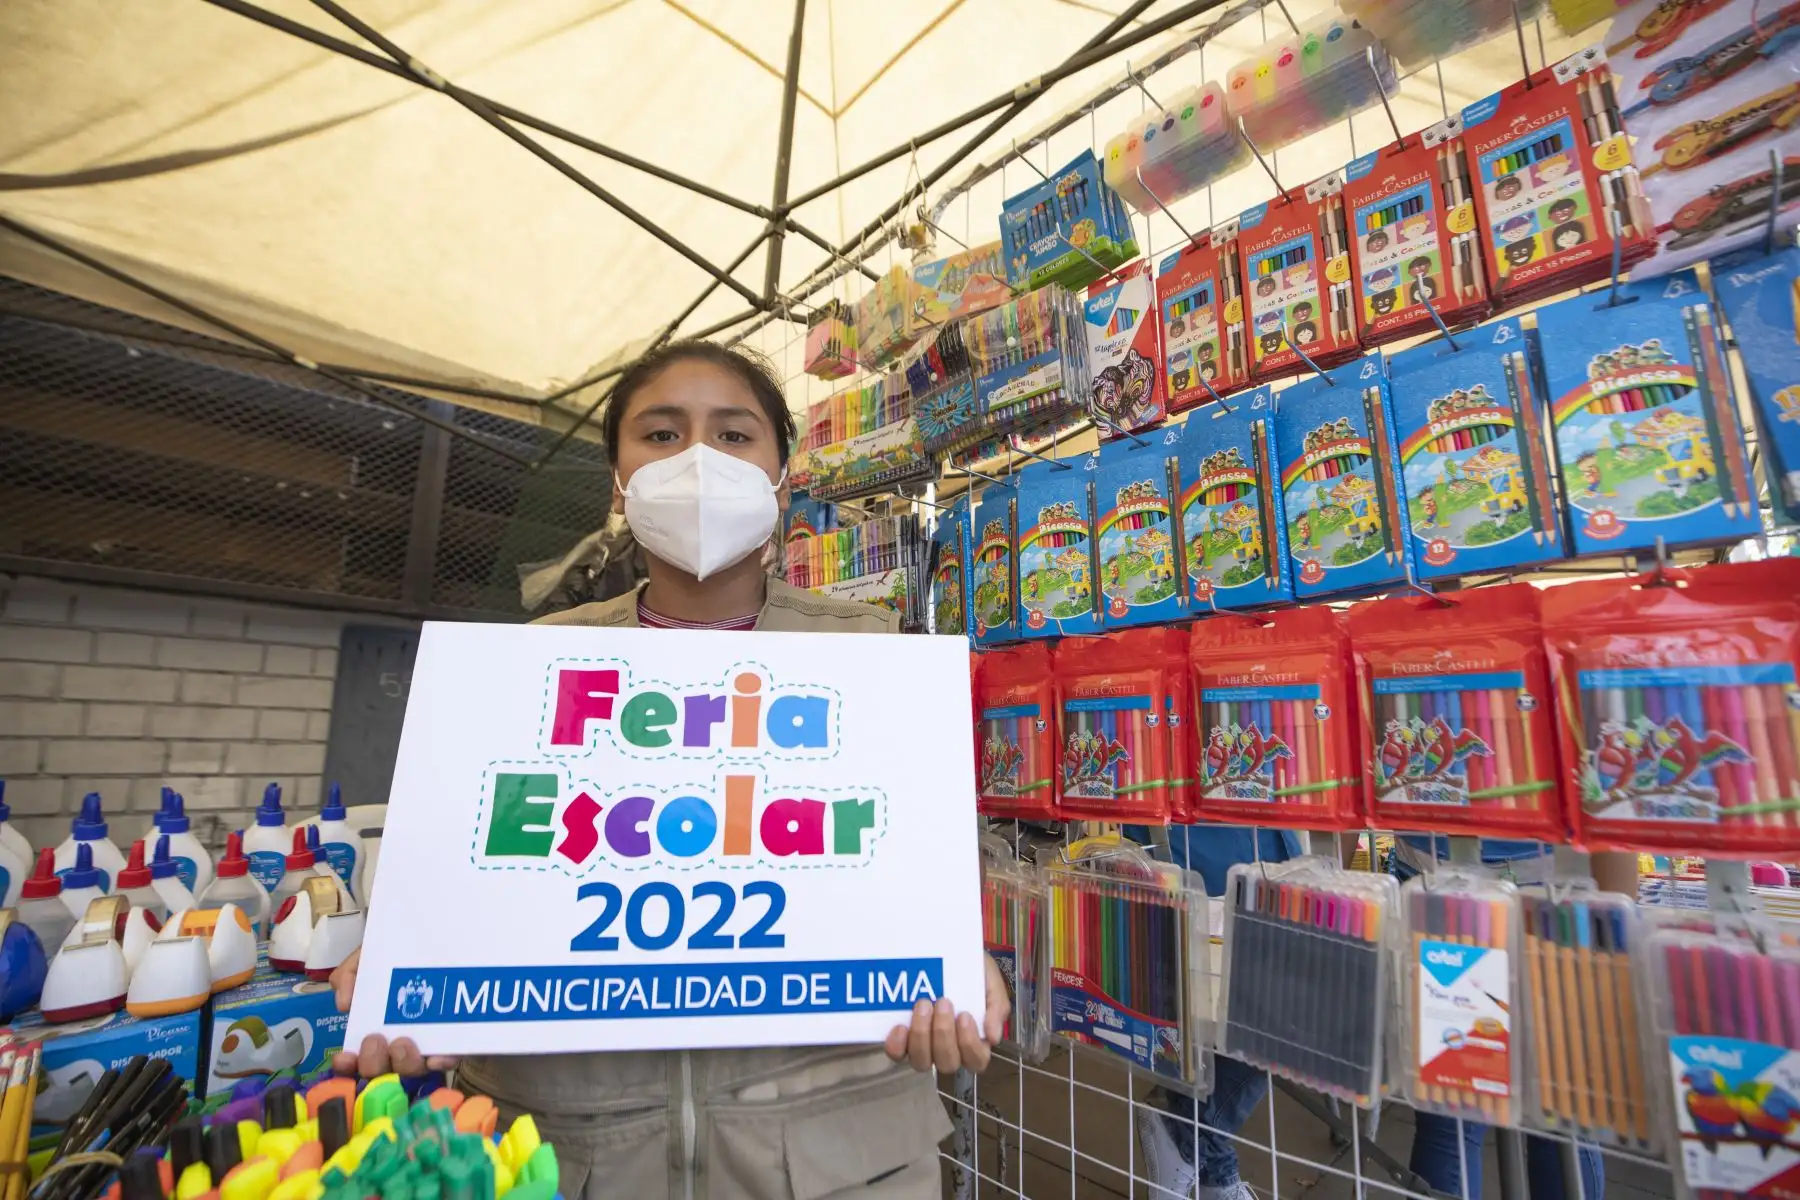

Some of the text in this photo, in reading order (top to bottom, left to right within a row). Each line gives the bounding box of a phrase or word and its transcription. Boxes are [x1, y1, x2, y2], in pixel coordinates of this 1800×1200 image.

[1030, 231, 1060, 252] CRAYONE
[1547, 258, 1558, 269] 15
[1403, 312, 1413, 320] 15
[1430, 411, 1501, 436] Picasso
[1304, 442, 1361, 466] Picasso
[1201, 472, 1248, 489] Picasso
[1117, 501, 1162, 515] Picasso
[1039, 522, 1082, 534] Picasso
[550, 669, 830, 748] Feria
[484, 773, 876, 864] Escolar
[570, 880, 787, 952] 2022
[453, 970, 937, 1015] MUNICIPALIDAD DE LIMA
